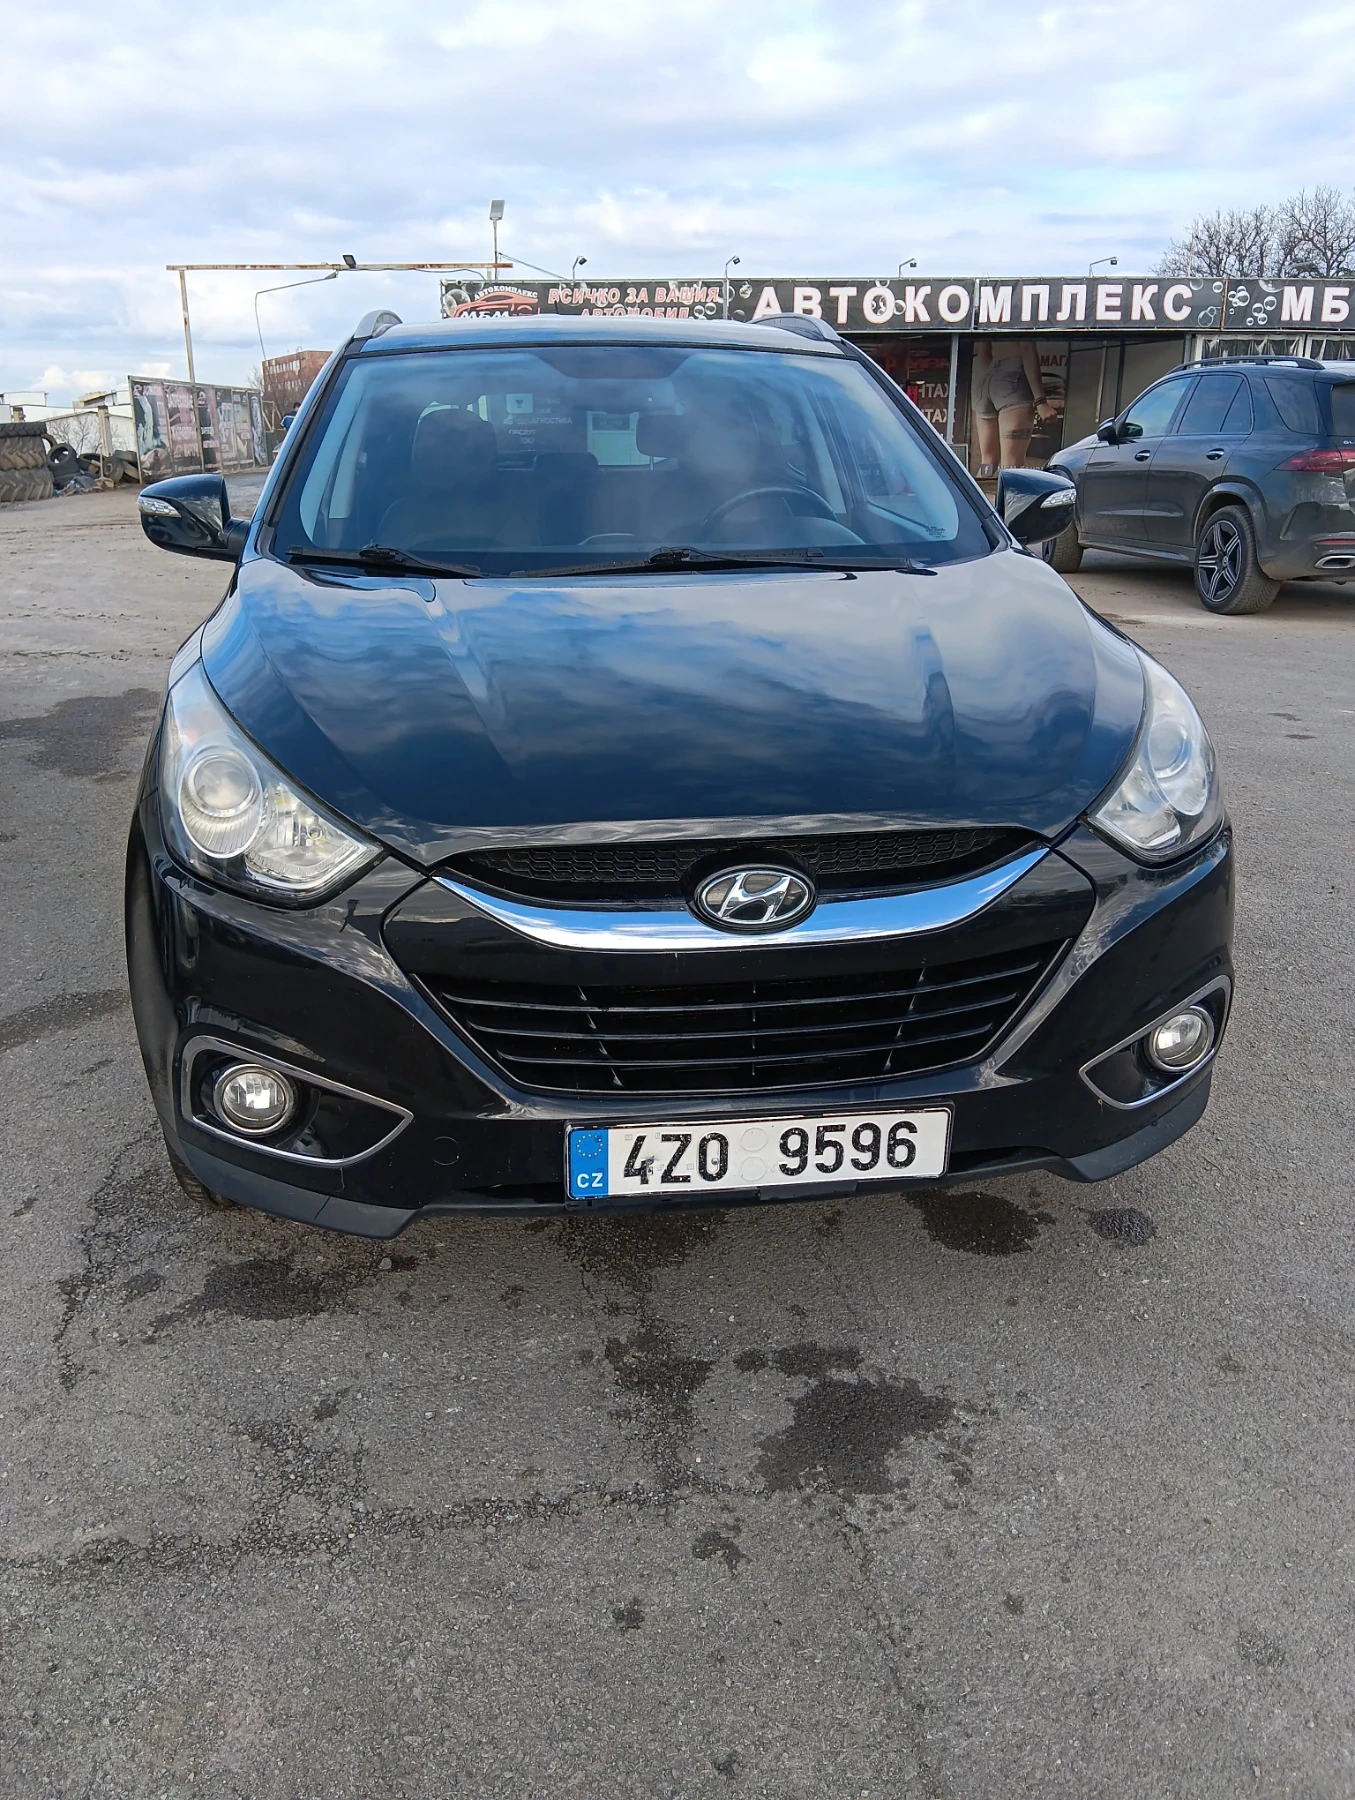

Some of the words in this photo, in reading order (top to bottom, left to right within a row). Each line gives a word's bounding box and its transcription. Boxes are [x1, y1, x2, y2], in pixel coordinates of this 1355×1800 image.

[474, 285, 538, 300] АВТОКОМПЛЕКС
[547, 287, 621, 304] ВСИЧКО
[626, 287, 649, 304] ЗА
[655, 286, 720, 304] ВАШИЯ
[752, 284, 1193, 324] АВТОКОМПЛЕКС
[1280, 285, 1350, 323] МБ
[622, 1132, 729, 1186] 4Z0
[778, 1120, 918, 1177] 9596
[576, 1172, 604, 1188] CZ
